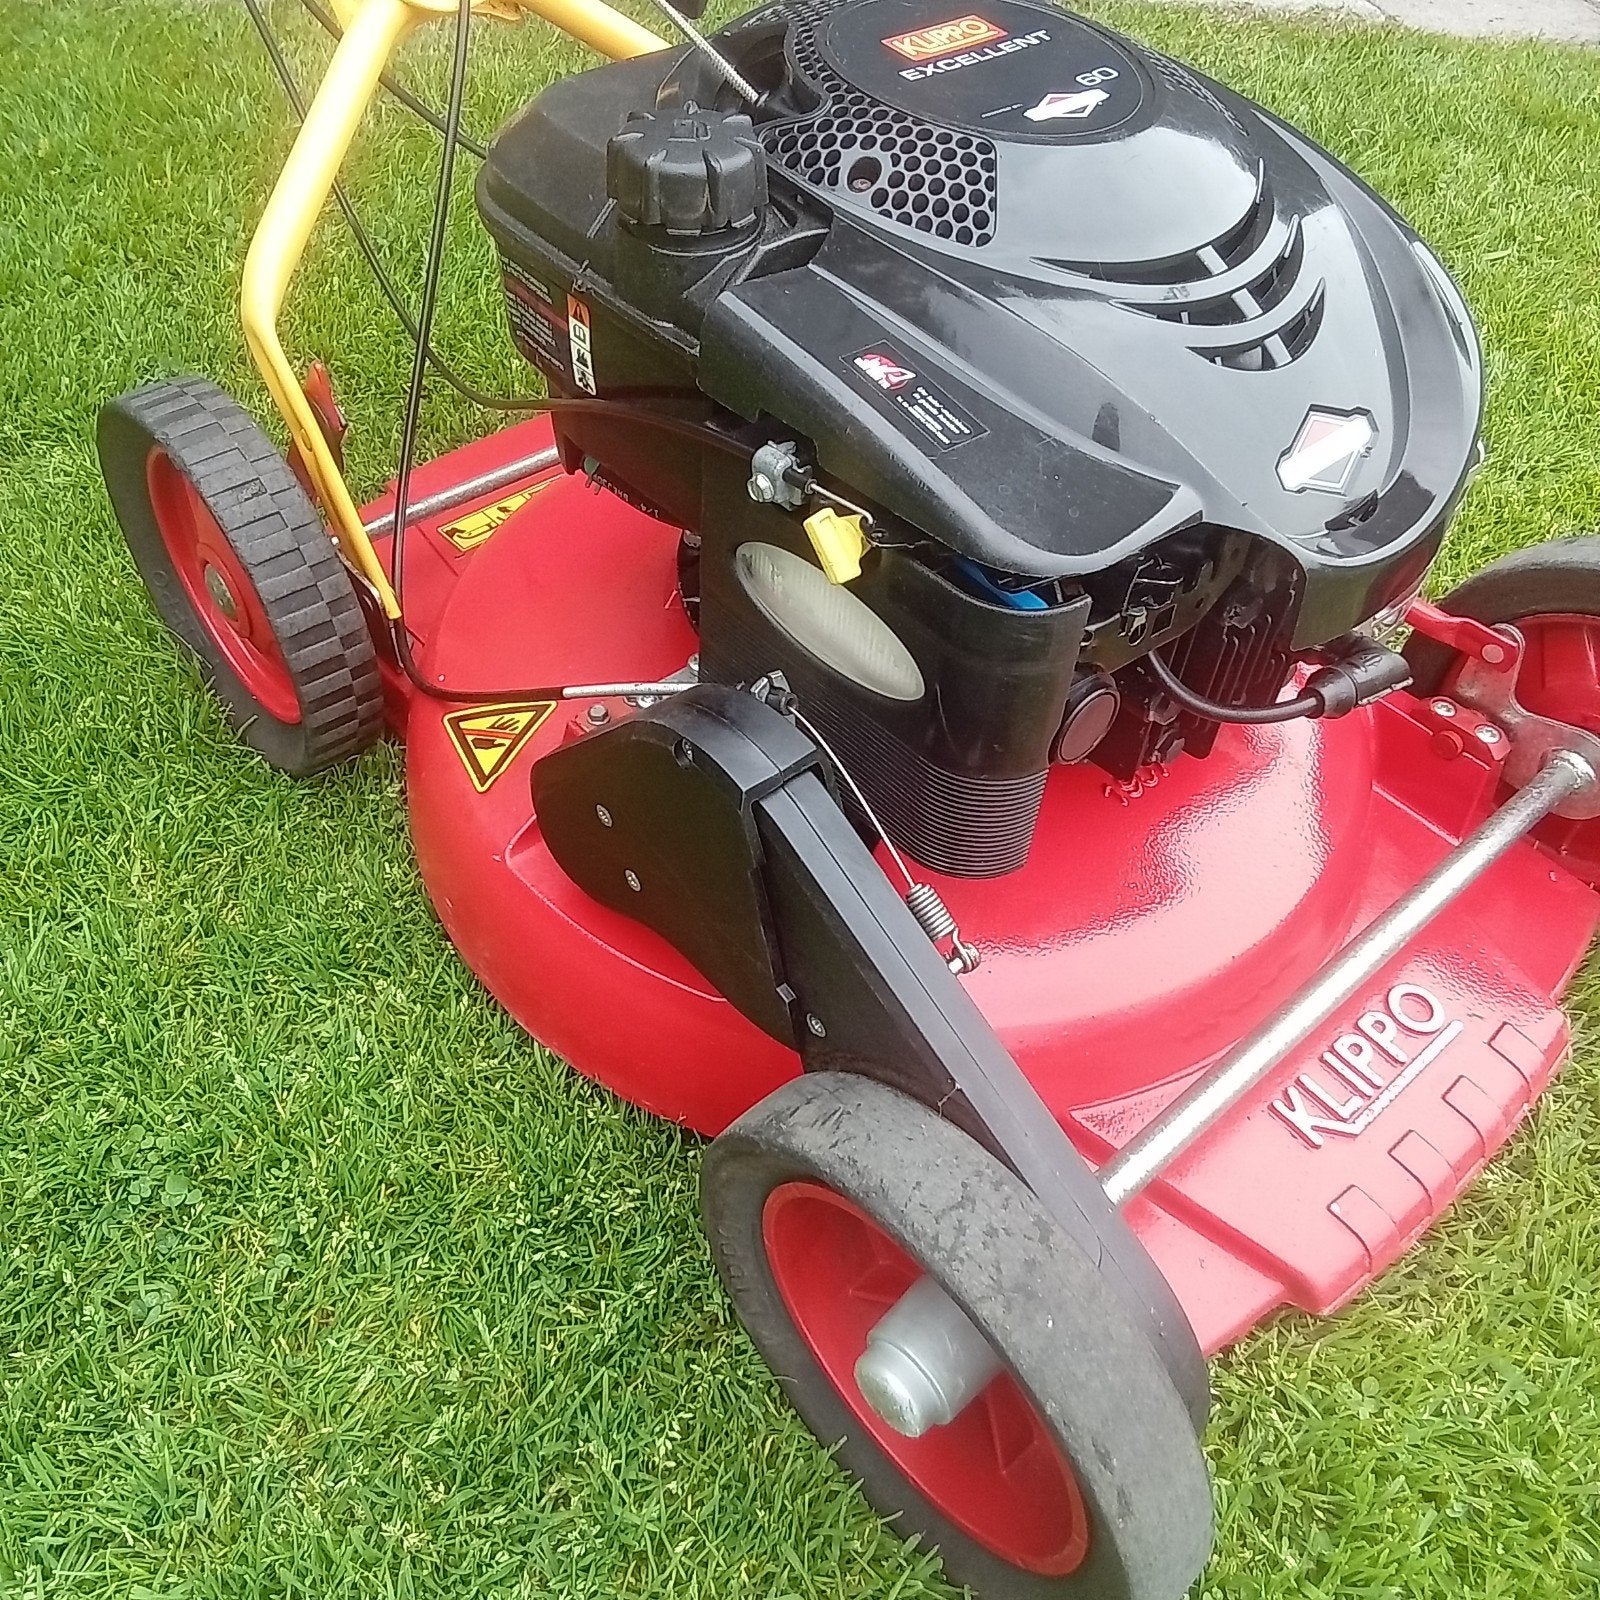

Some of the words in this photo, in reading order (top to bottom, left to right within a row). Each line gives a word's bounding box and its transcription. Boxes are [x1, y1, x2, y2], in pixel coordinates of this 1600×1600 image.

[890, 19, 998, 57] KLIPPO
[899, 29, 1052, 82] EXCELLENT
[1075, 67, 1120, 87] 60
[1267, 982, 1446, 1150] KLIPPO
